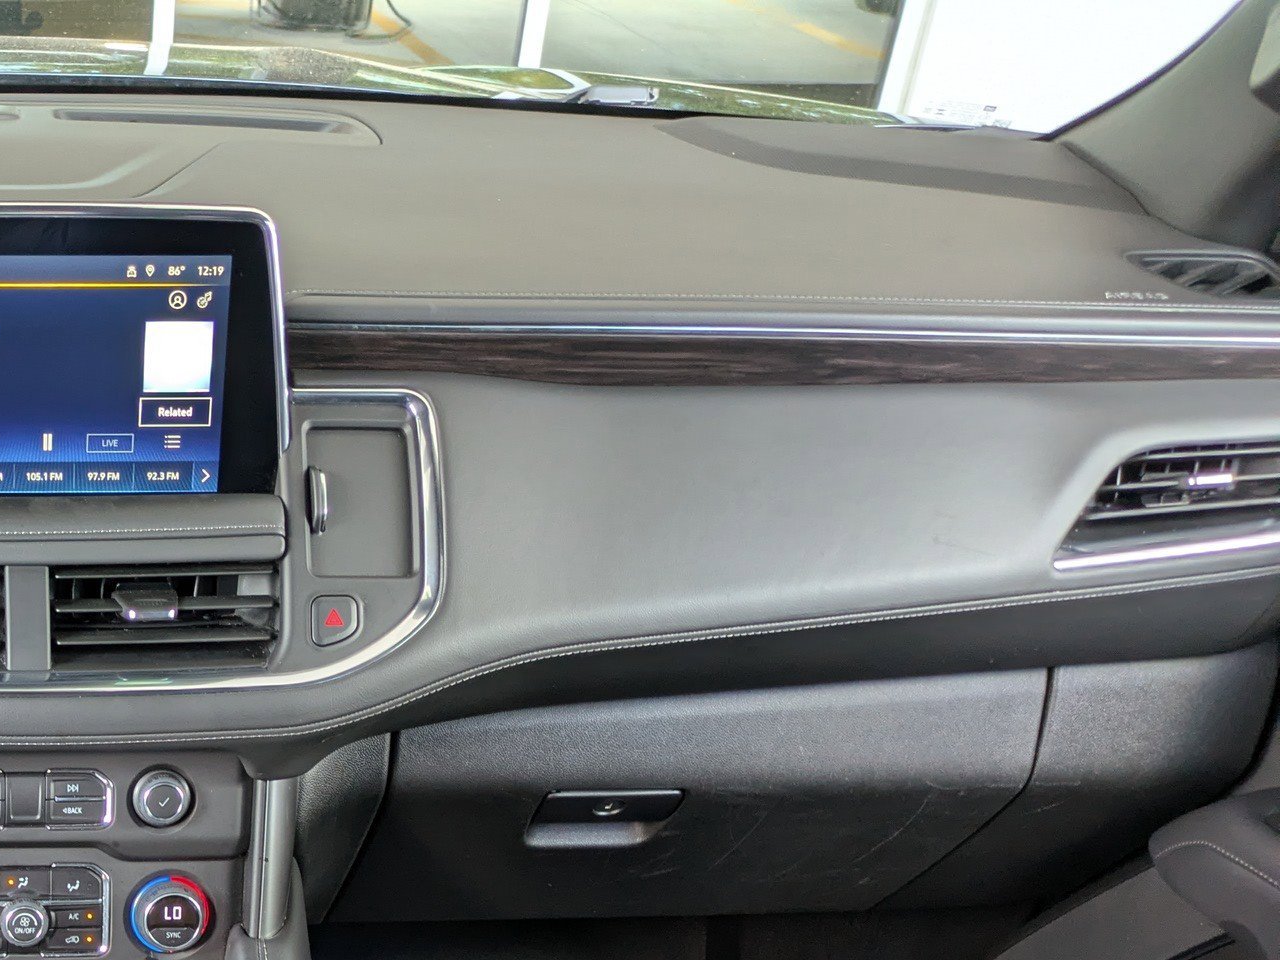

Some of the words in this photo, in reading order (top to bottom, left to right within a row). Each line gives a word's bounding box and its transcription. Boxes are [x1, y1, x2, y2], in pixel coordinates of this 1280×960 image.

[198, 266, 224, 276] 12:19
[158, 407, 193, 418] Related
[101, 440, 119, 448] LIVE
[26, 472, 48, 482] 105.1
[50, 472, 63, 481] FM
[87, 472, 106, 482] 97.9
[107, 472, 120, 481] FM
[147, 472, 165, 482] 92.3
[166, 472, 179, 481] FM
[164, 906, 182, 920] LO
[166, 931, 181, 939] SYNC
